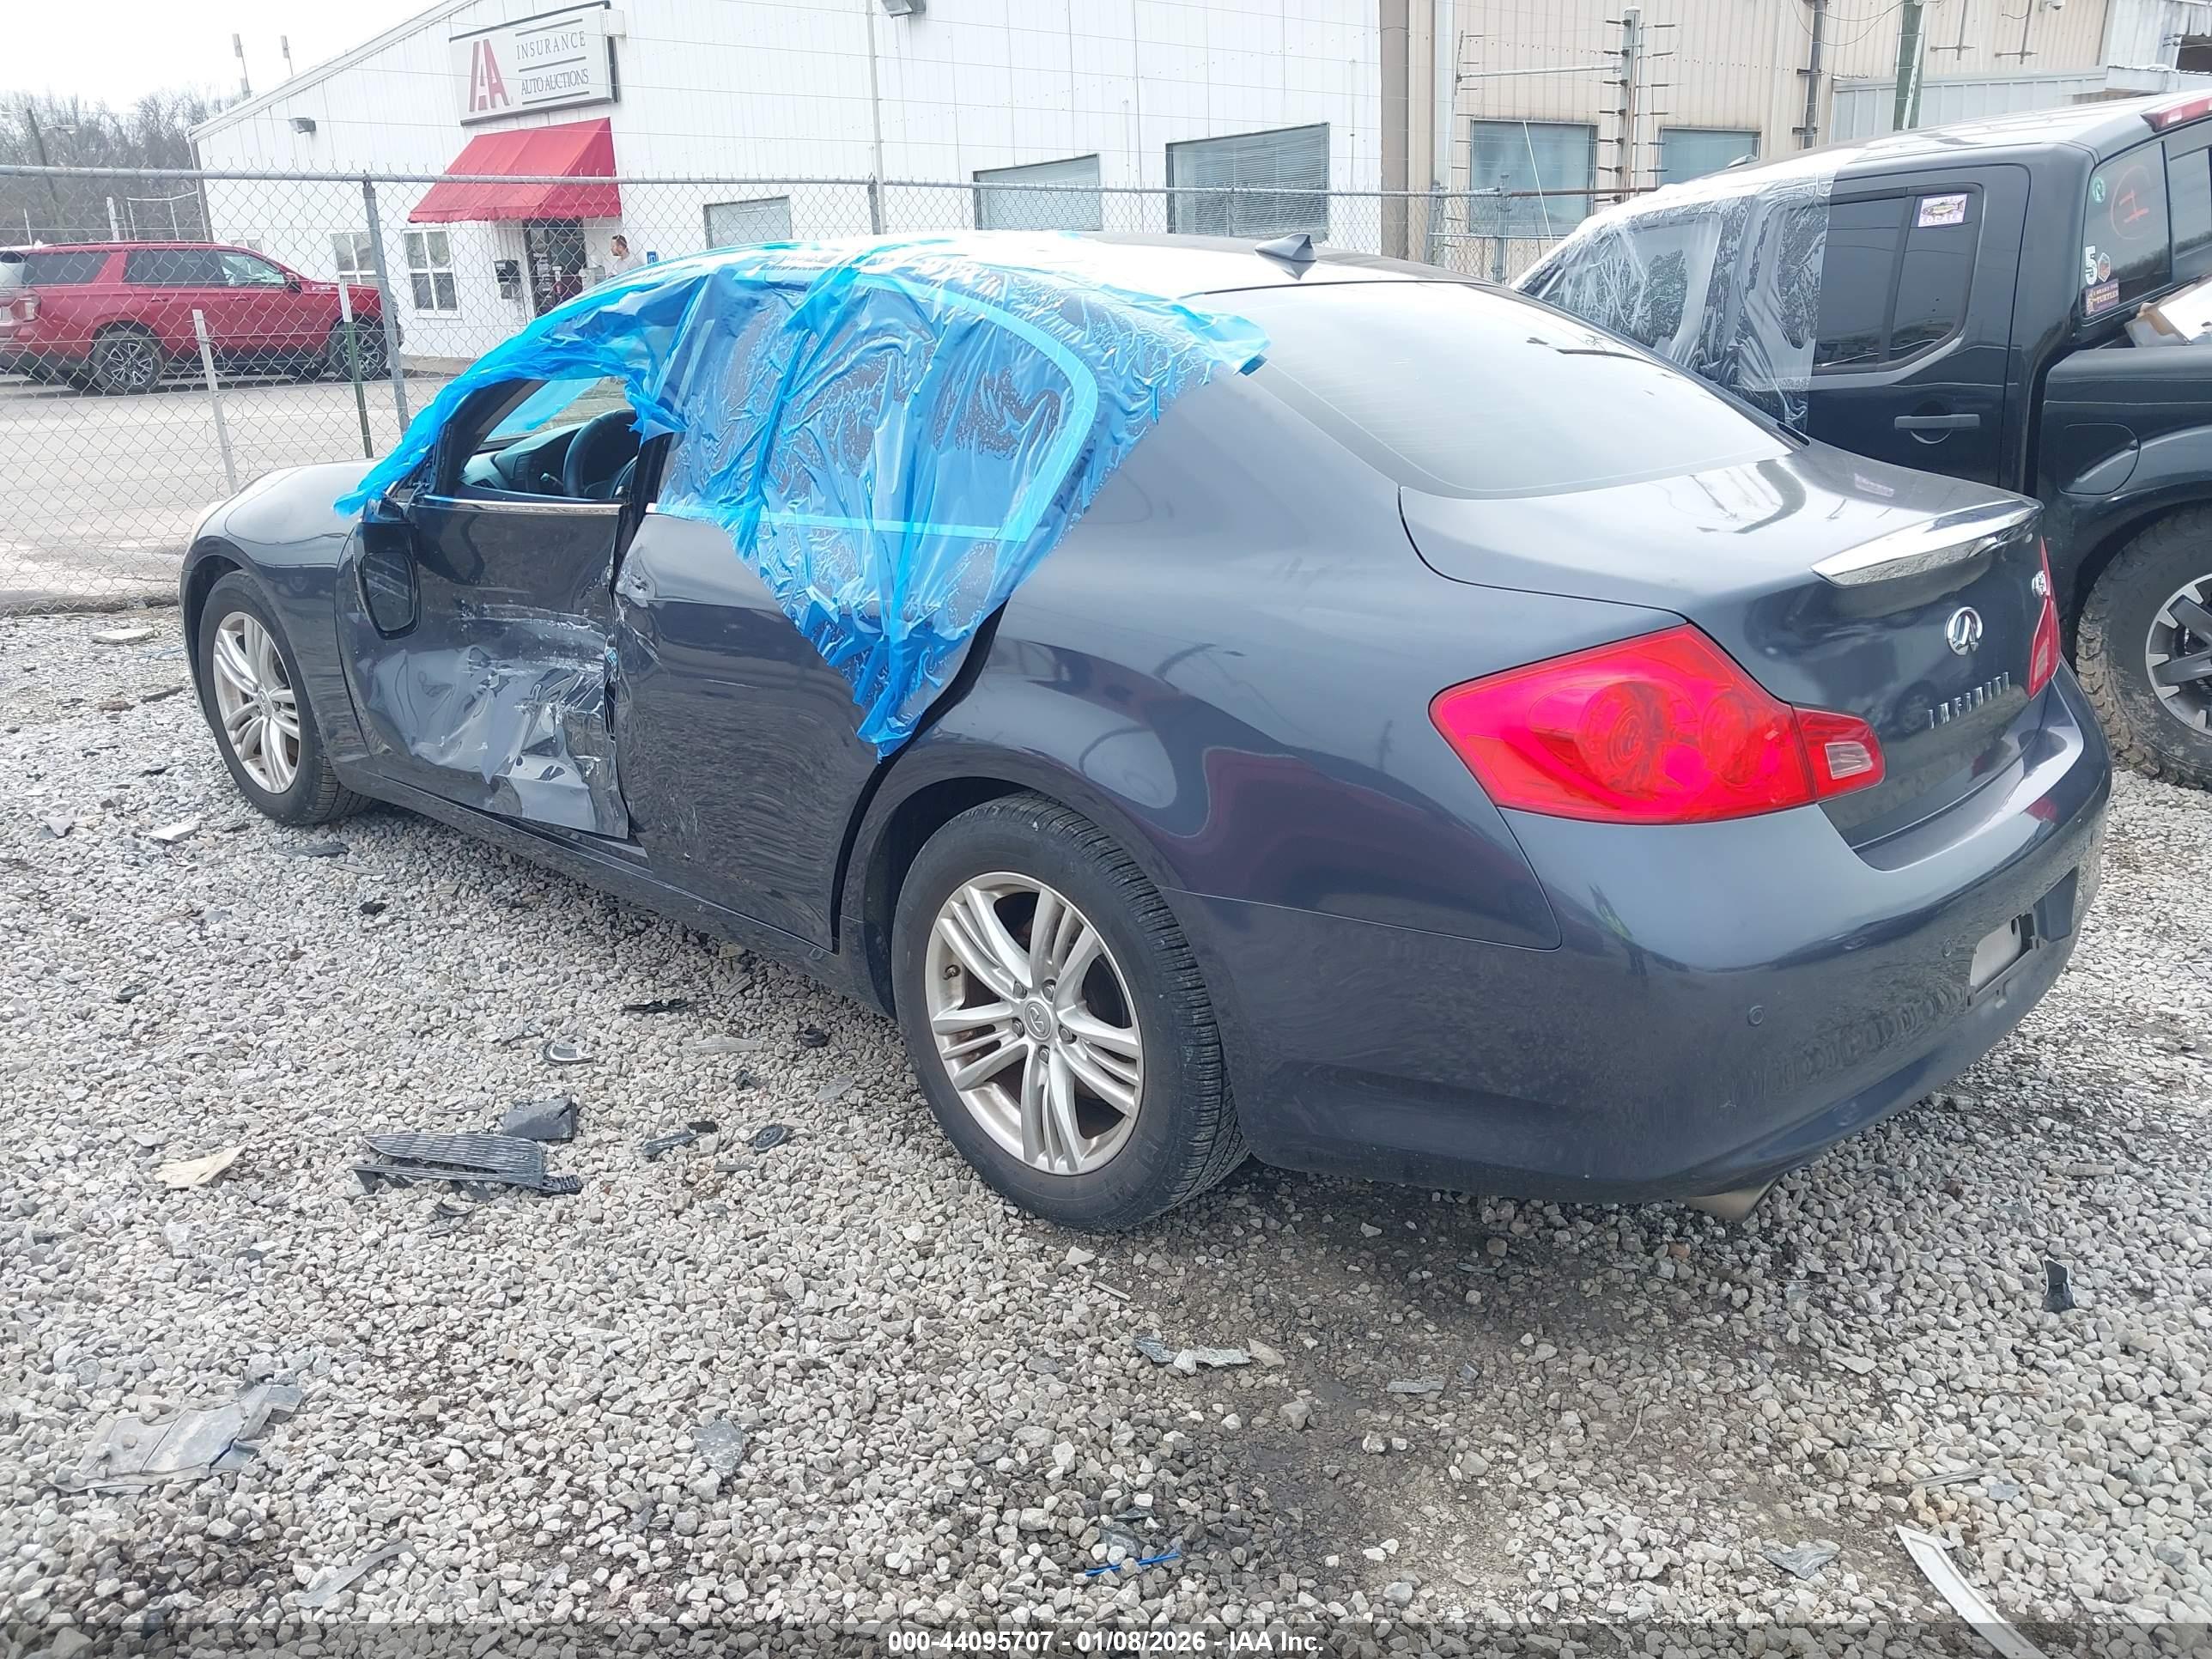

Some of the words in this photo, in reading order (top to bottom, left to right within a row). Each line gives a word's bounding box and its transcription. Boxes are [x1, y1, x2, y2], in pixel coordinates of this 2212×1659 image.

[516, 31, 586, 60] INSURANCE
[521, 76, 544, 95] AUTO
[544, 68, 589, 91] AUCTIONS
